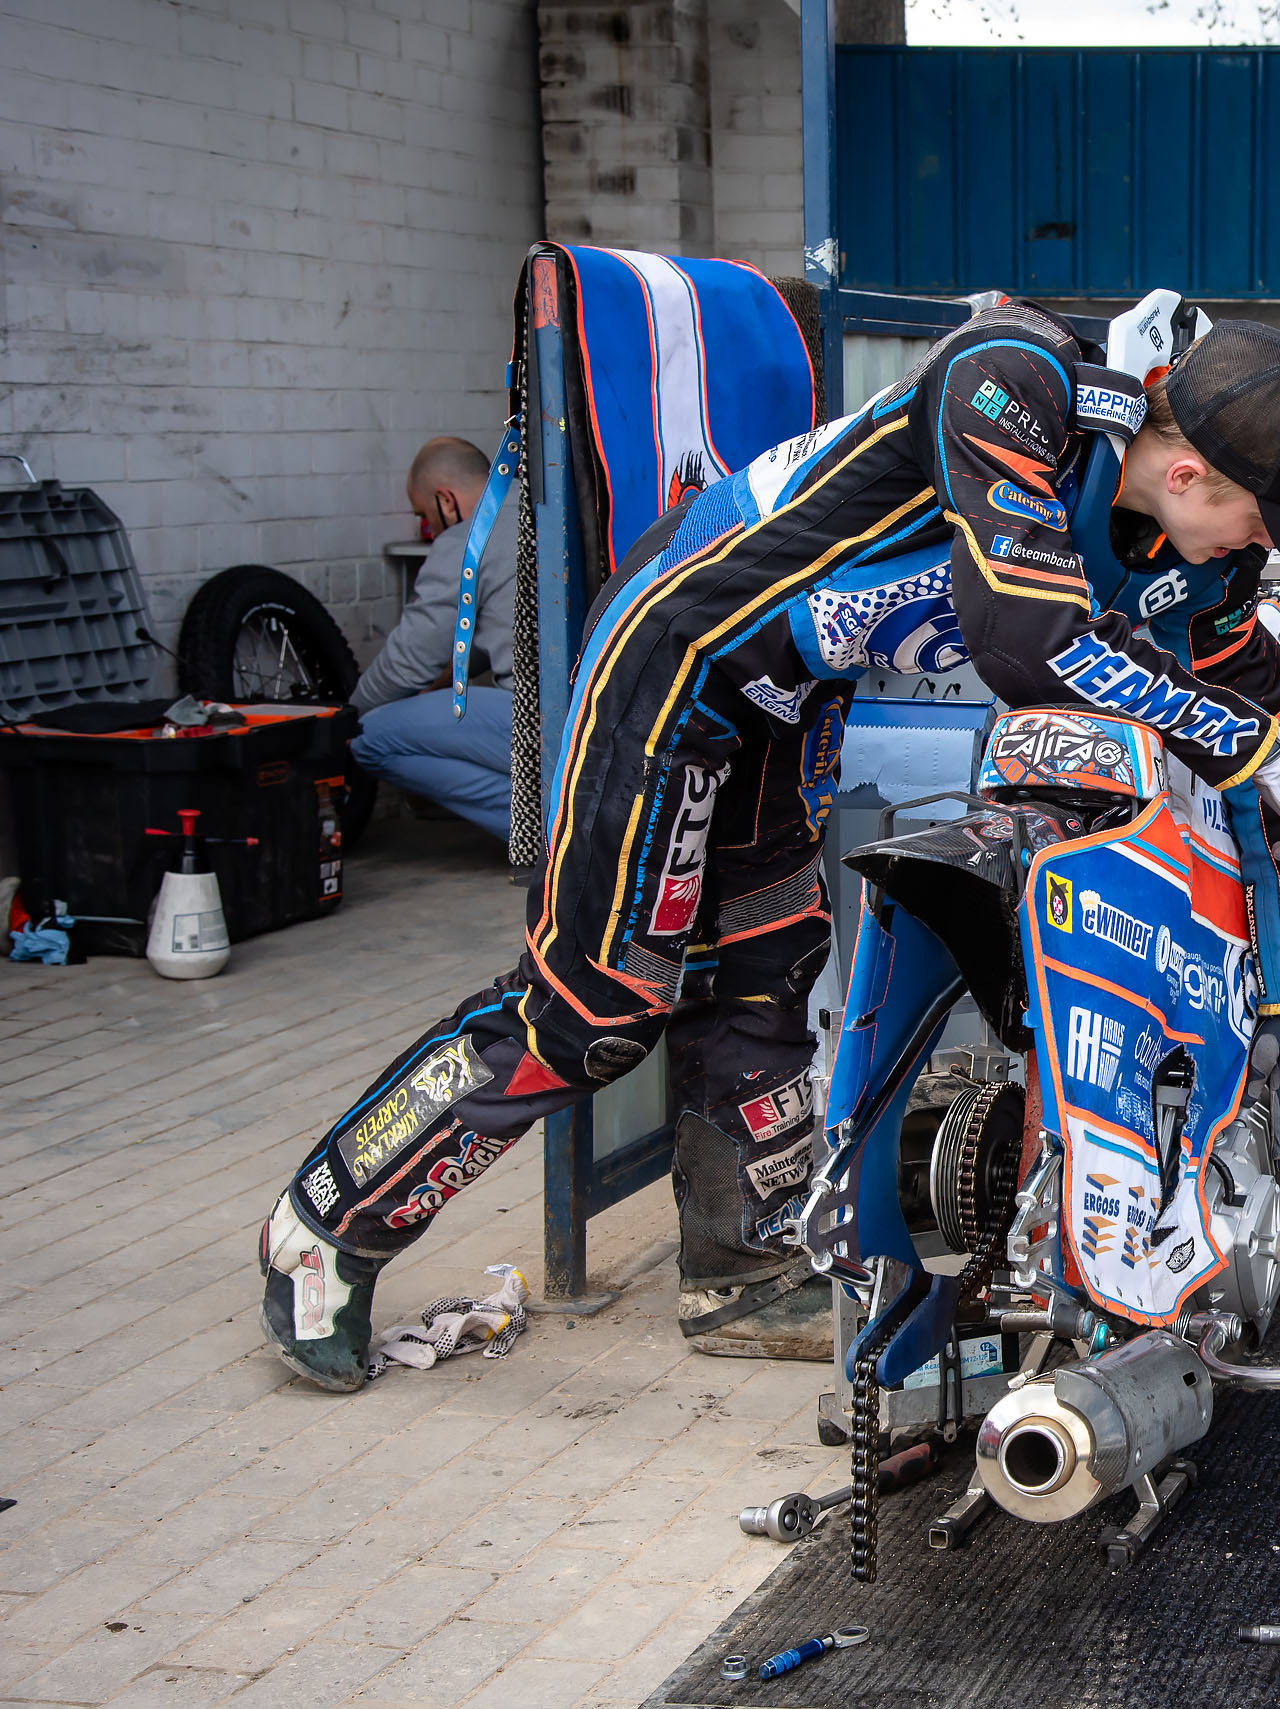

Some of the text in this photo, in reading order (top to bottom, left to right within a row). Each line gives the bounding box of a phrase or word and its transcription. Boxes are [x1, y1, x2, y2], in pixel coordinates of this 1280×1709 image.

[998, 416, 1047, 457] INSTALLATIONS
[1011, 542, 1077, 570] @teambach
[1046, 630, 1196, 729] TEAM
[355, 1087, 408, 1150] CARPETS
[754, 1112, 801, 1141] Fire Training
[1083, 1191, 1120, 1218] ERGOSS
